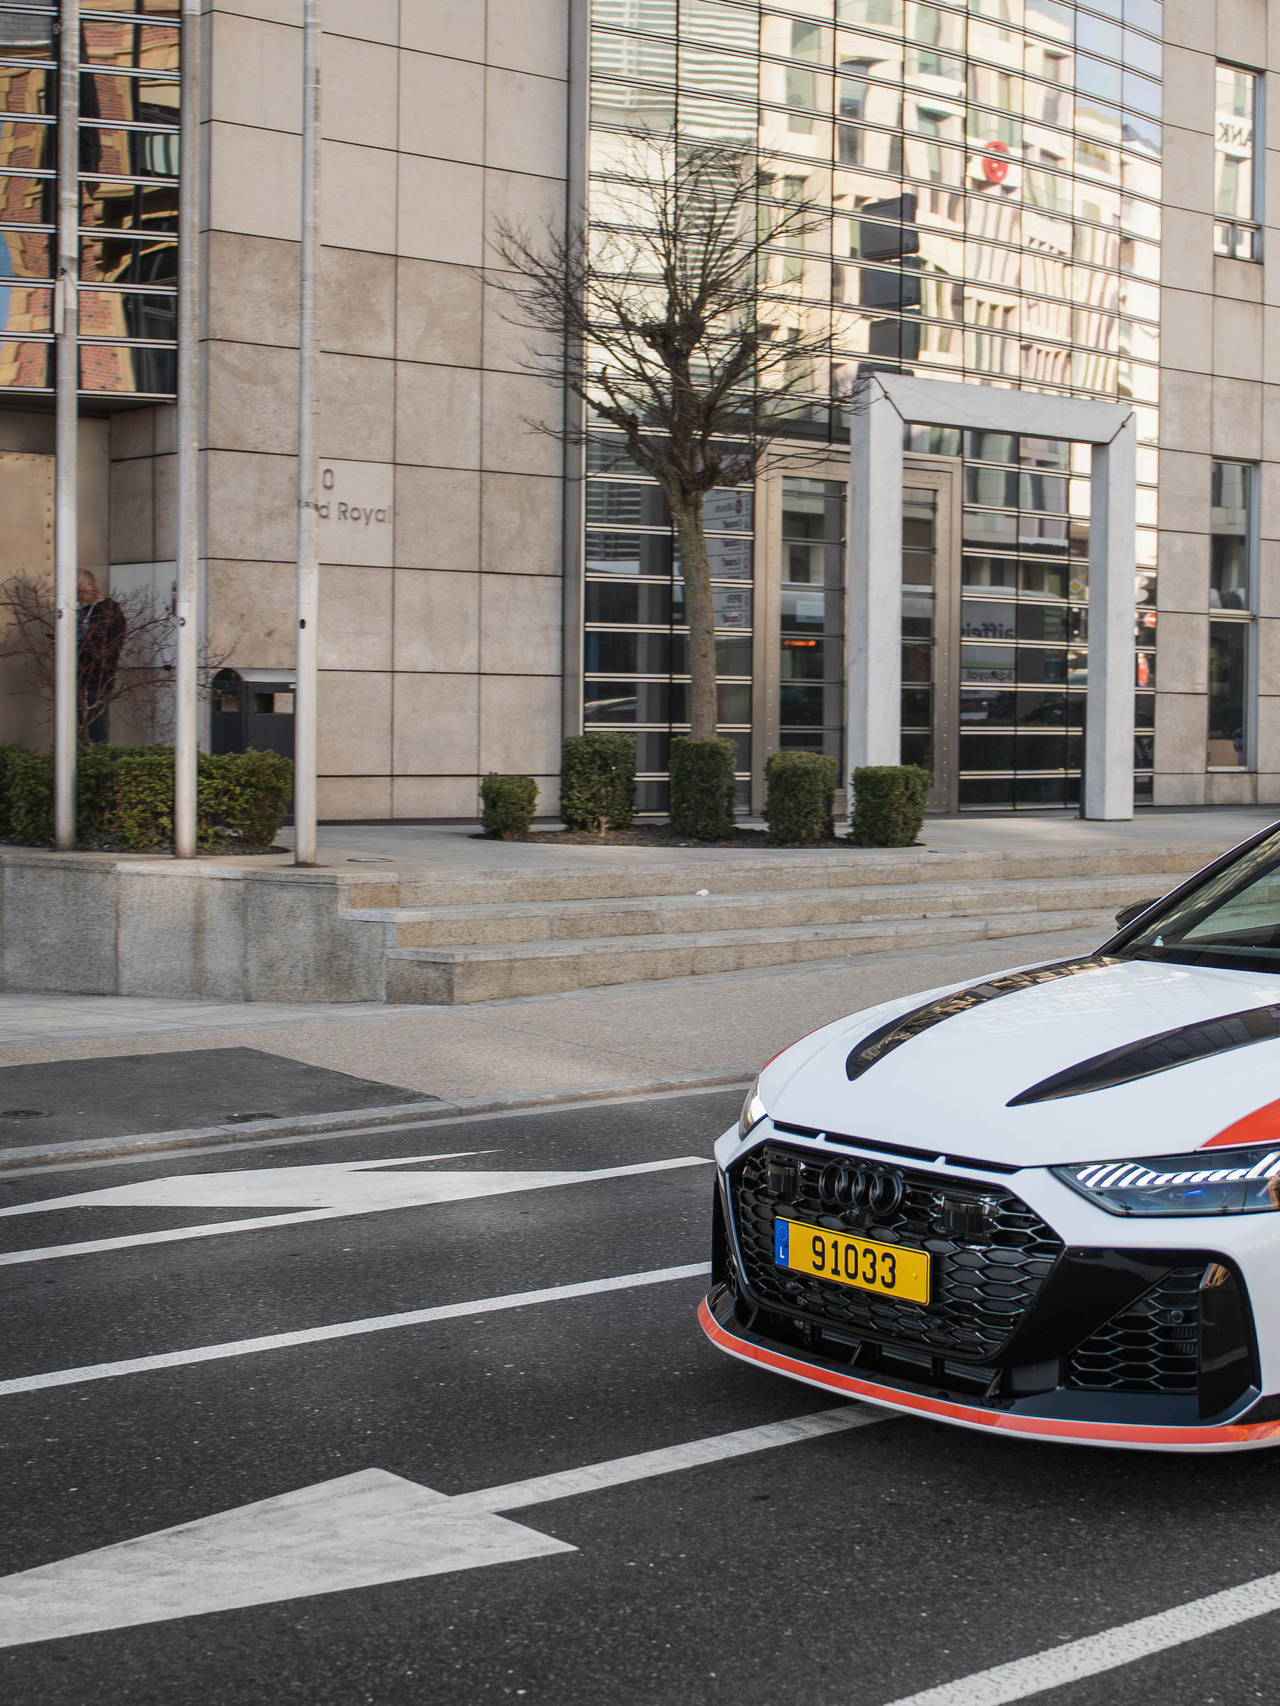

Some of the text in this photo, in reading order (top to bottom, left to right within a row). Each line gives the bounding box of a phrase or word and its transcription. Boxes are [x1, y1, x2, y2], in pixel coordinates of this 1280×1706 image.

[323, 468, 334, 490] 0
[338, 502, 392, 526] Royal
[779, 1235, 896, 1288] L 91033
